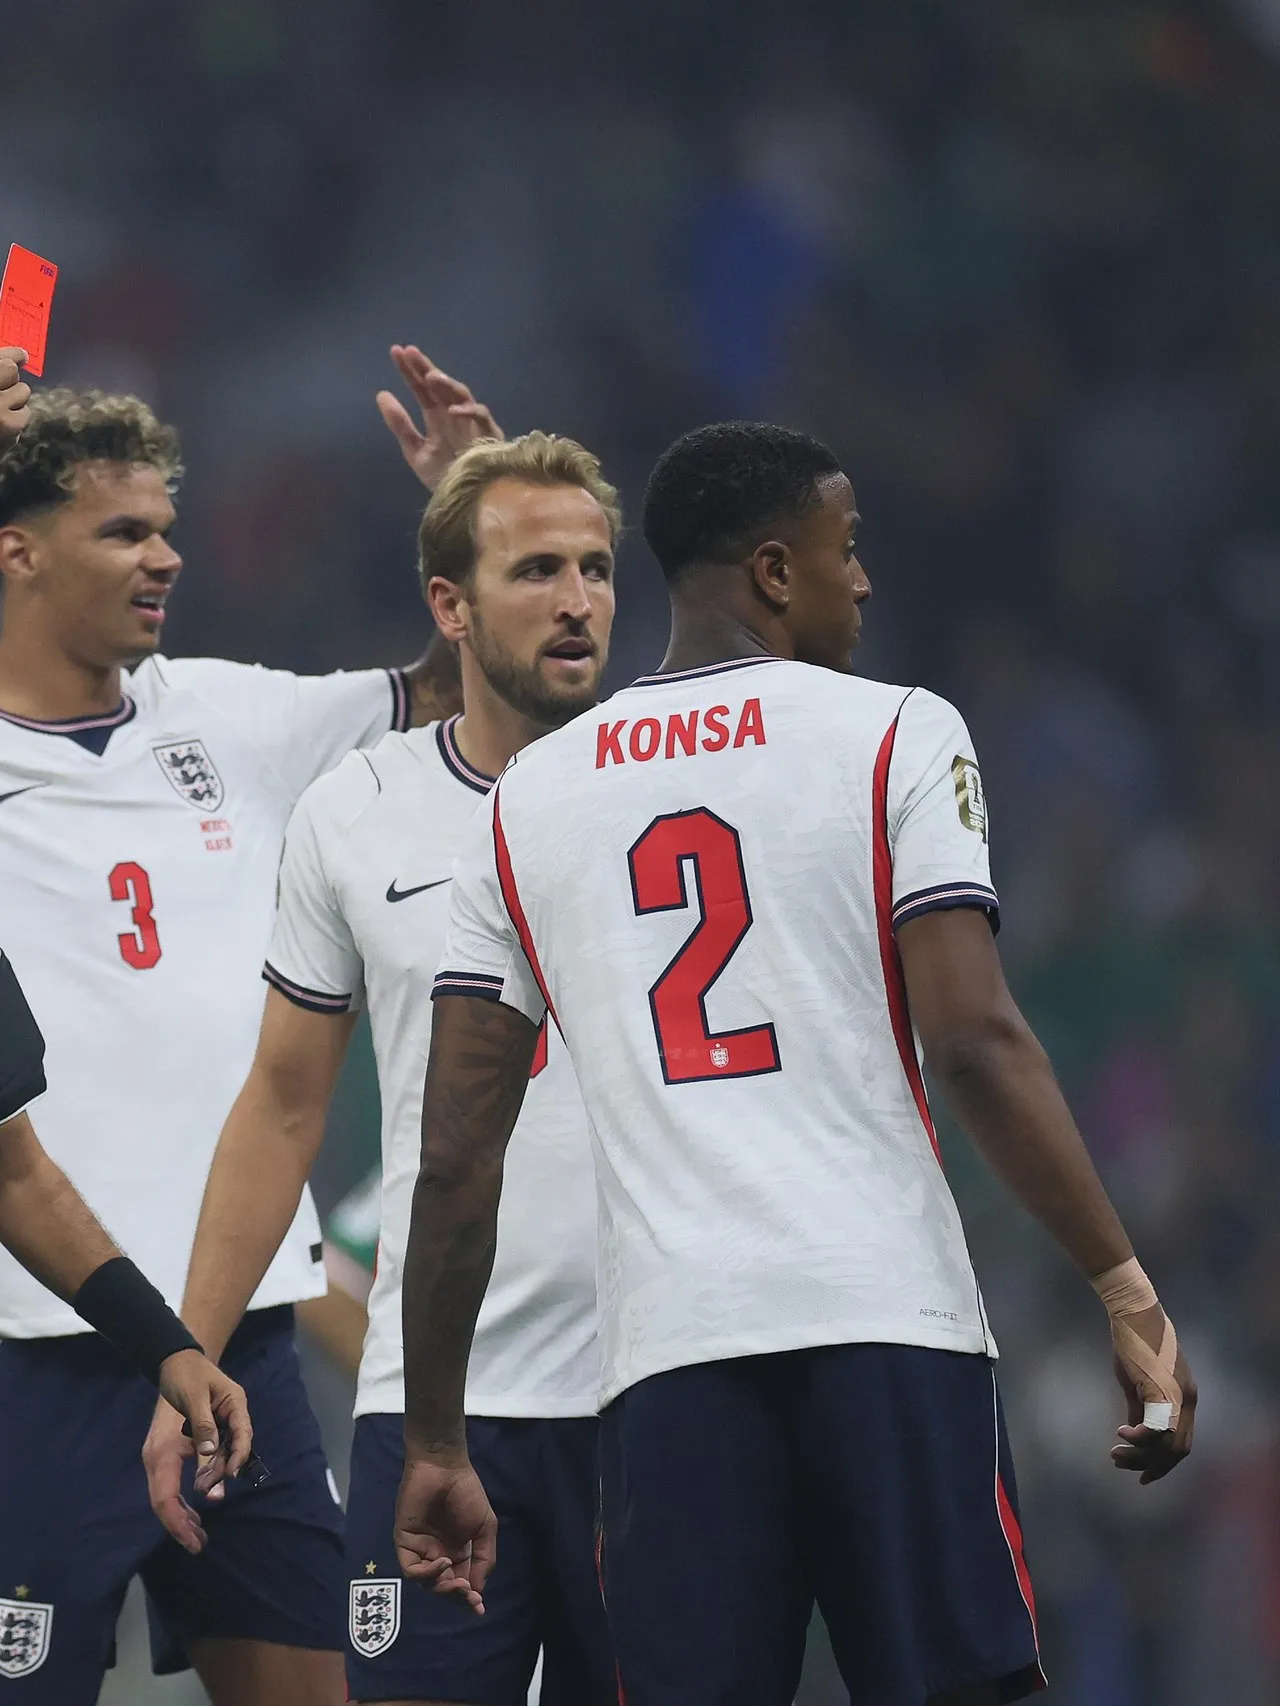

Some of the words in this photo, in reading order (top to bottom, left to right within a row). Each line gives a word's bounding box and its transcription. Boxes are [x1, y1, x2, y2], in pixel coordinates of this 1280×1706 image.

[595, 698, 767, 770] KONSA
[108, 861, 162, 970] 3
[627, 806, 782, 1085] 2
